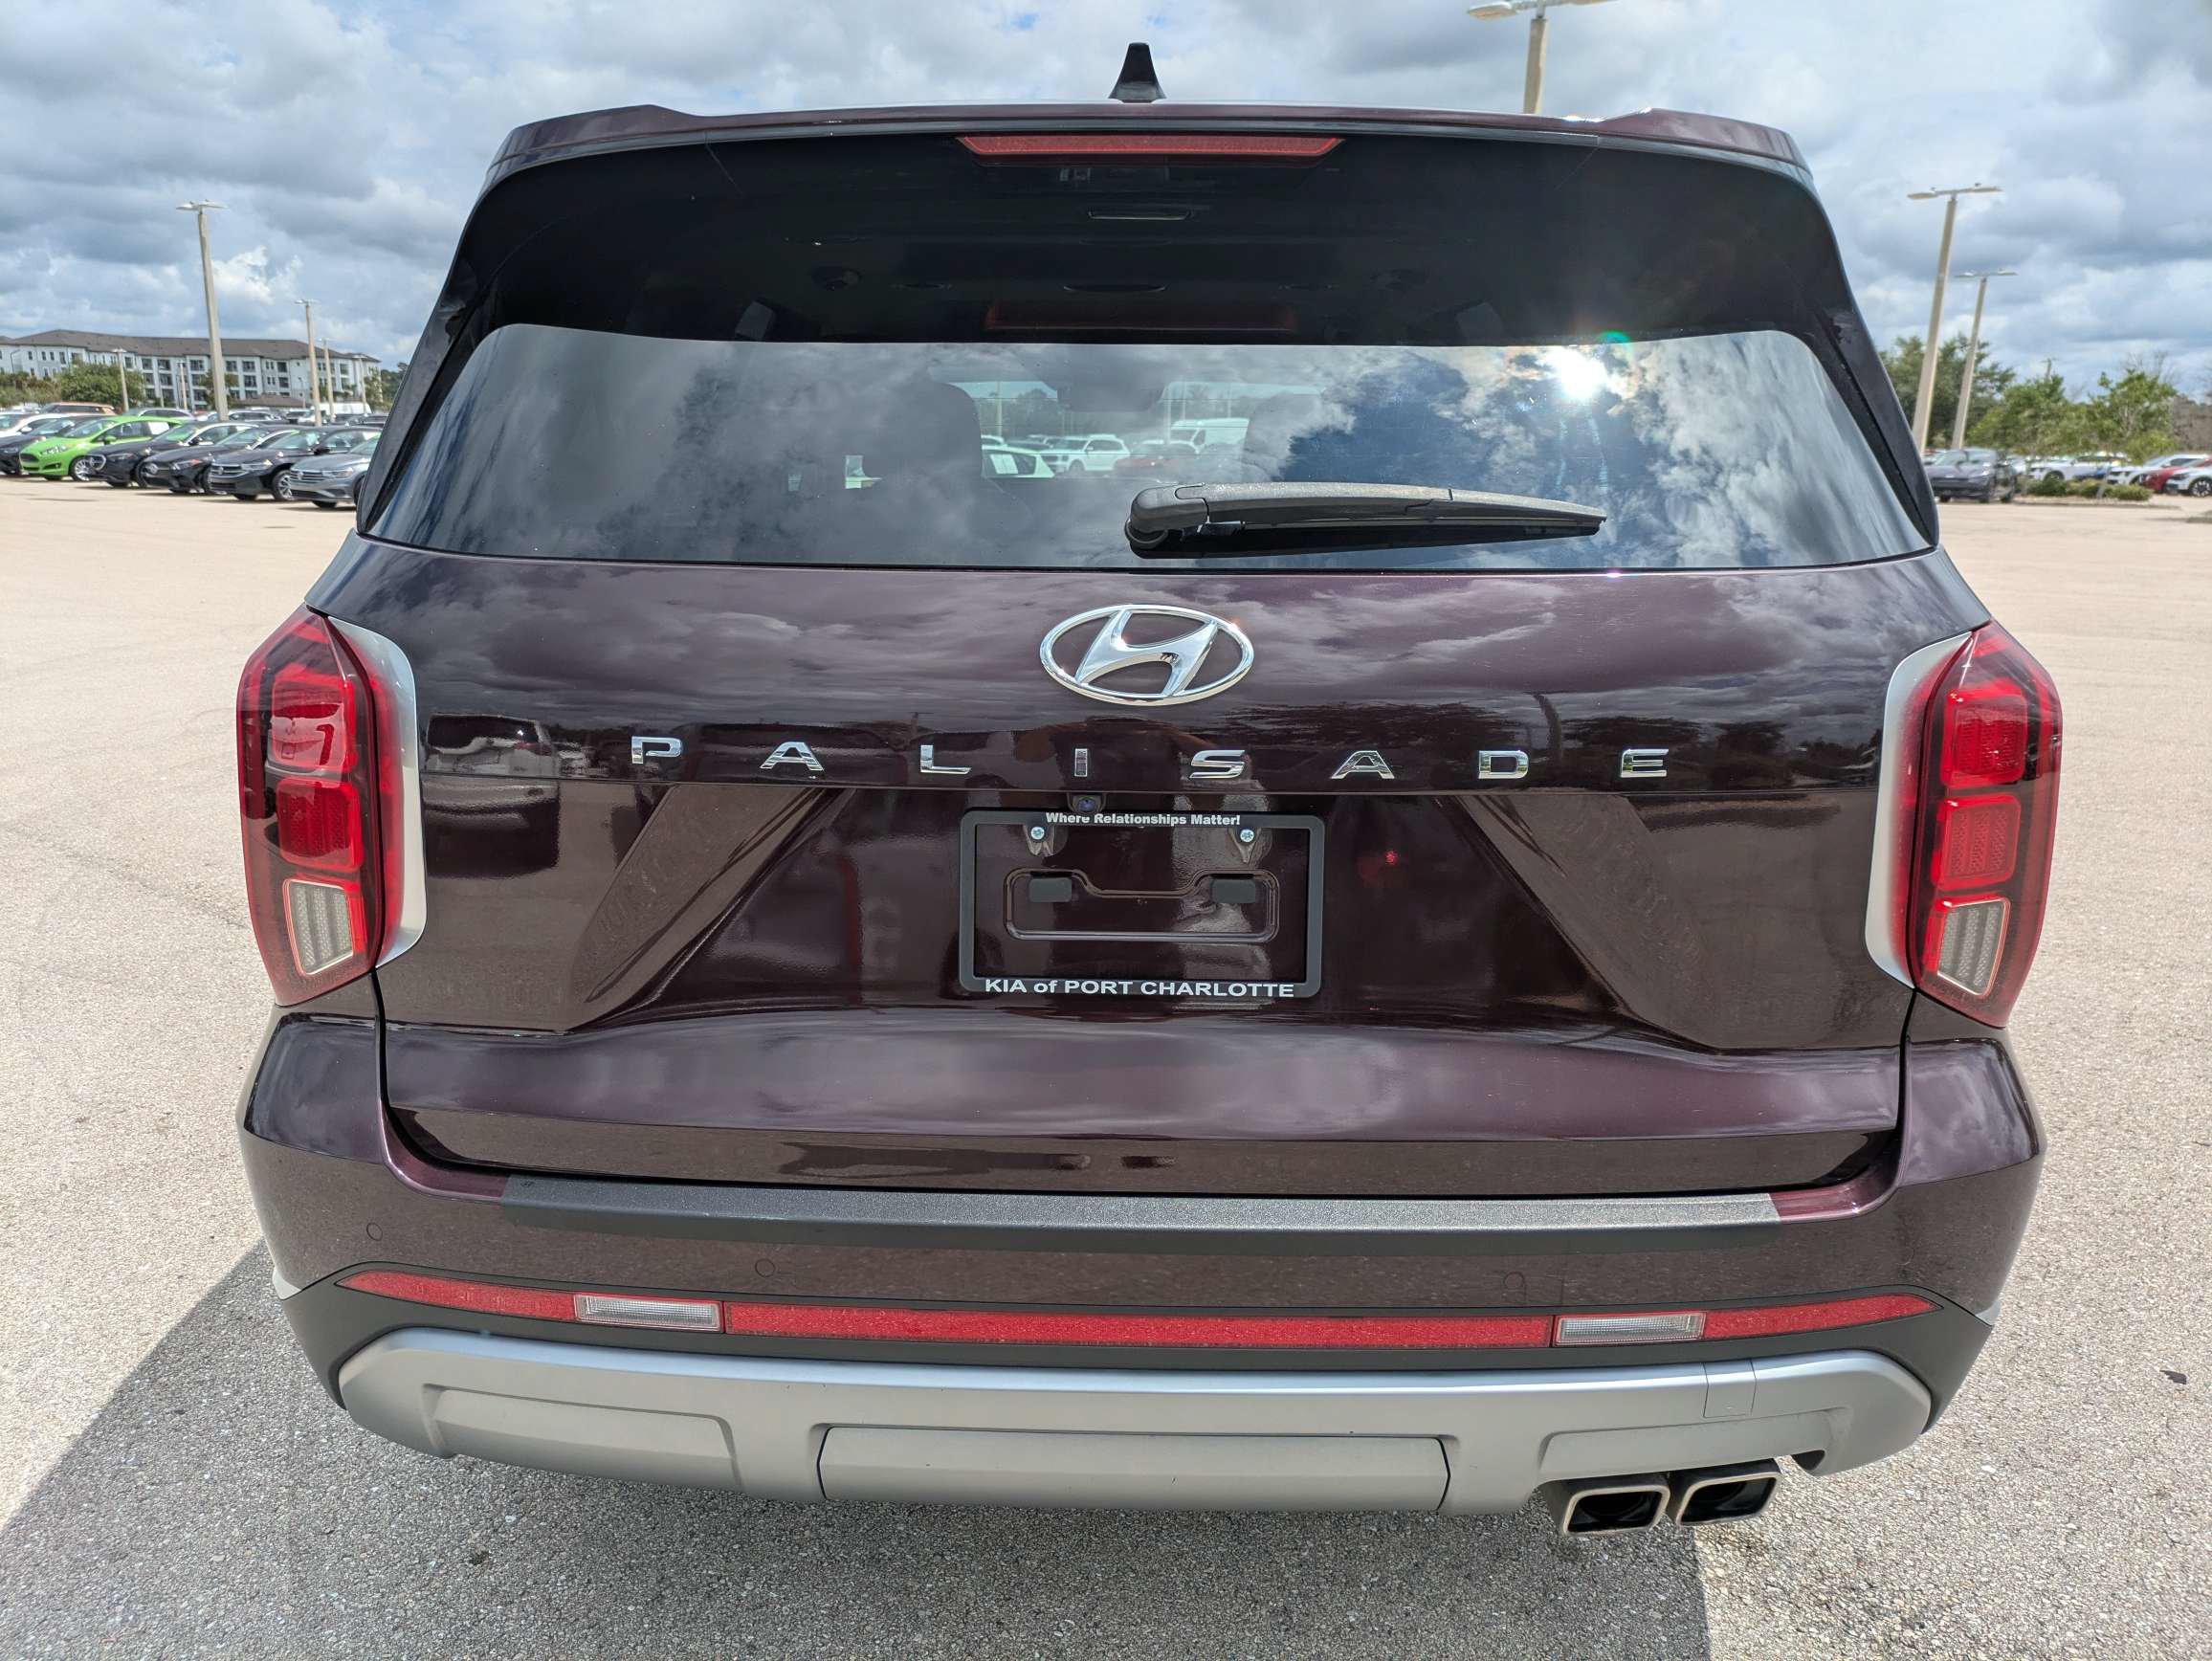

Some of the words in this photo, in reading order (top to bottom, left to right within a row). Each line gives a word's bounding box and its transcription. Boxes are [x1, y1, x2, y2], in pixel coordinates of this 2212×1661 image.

[630, 735, 1670, 780] PALISADE
[1045, 811, 1091, 824] Where
[1094, 812, 1187, 827] Relationships
[1190, 814, 1241, 826] Matter!
[984, 979, 1027, 993] KIA
[1033, 980, 1058, 993] of
[1064, 980, 1134, 994] PORT
[1139, 981, 1294, 998] CHARLOTTE
